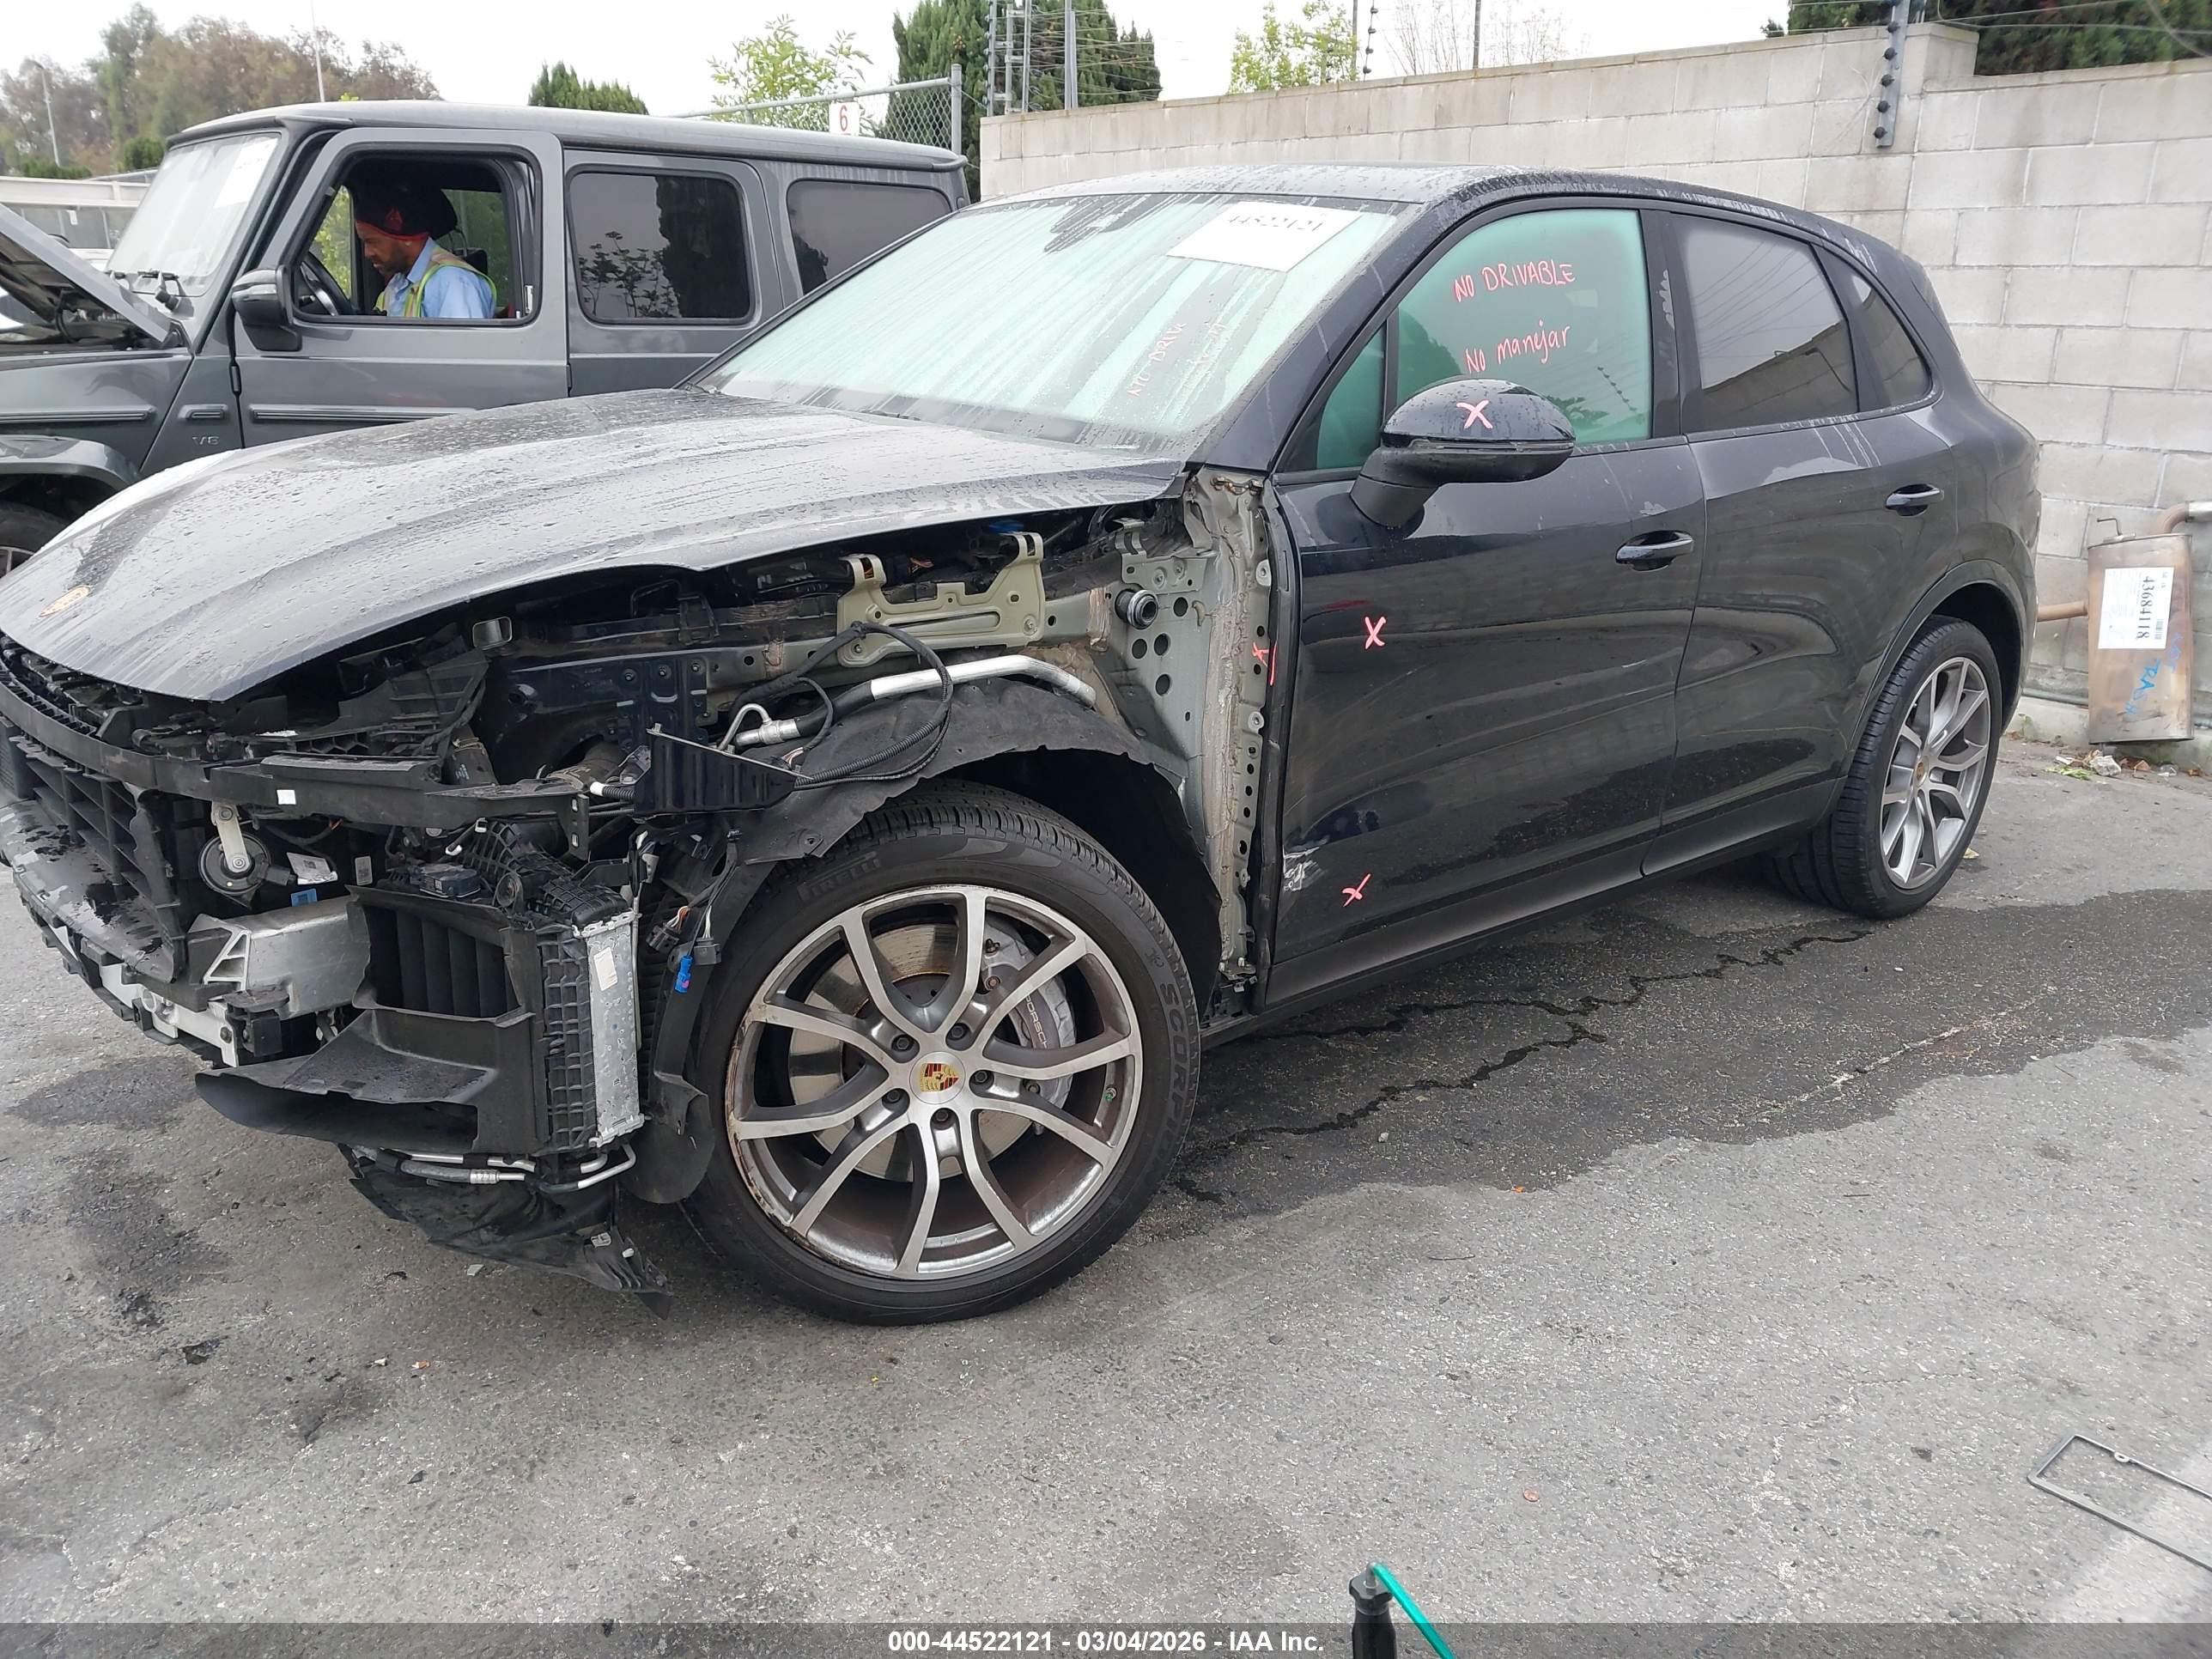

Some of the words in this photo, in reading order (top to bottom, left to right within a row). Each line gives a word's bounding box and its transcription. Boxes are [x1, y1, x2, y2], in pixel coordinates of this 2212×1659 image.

[839, 105, 848, 131] 6
[1453, 274, 1475, 303] NO
[1481, 258, 1576, 291] DRIVABLE
[1497, 319, 1571, 364] manejar
[2136, 575, 2155, 640] 43684118
[1025, 994, 1048, 1049] PORSCH
